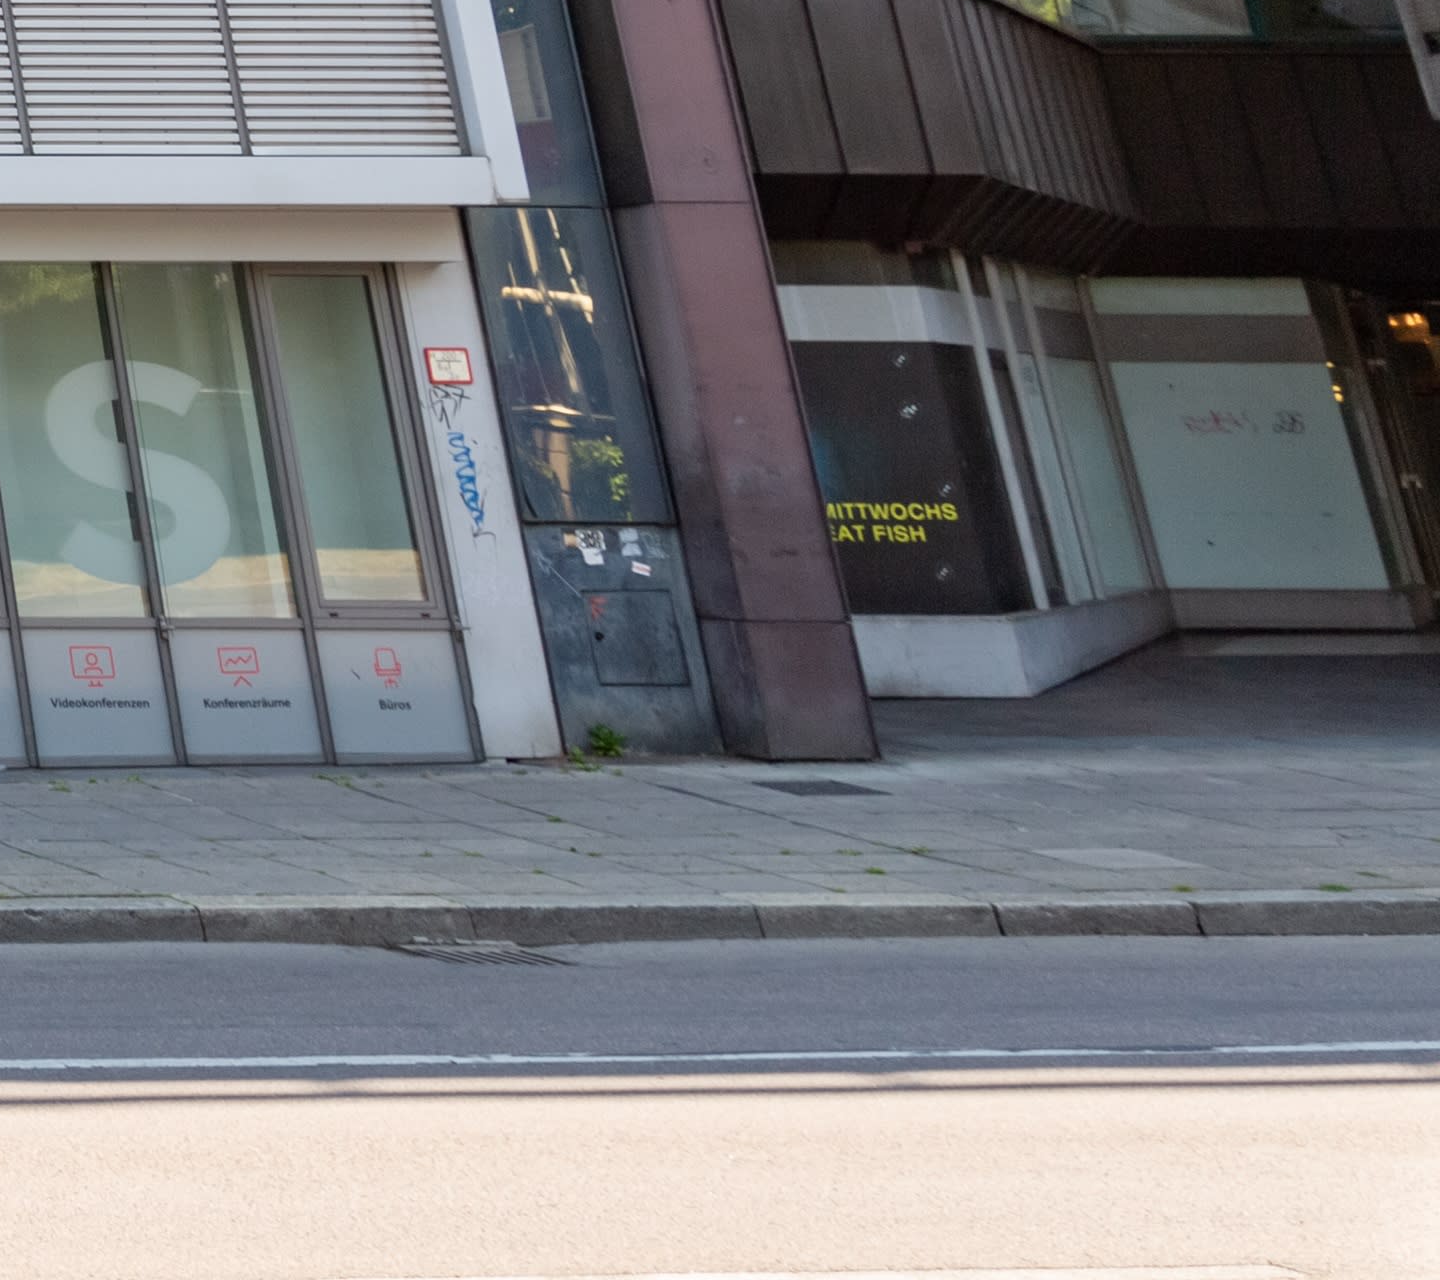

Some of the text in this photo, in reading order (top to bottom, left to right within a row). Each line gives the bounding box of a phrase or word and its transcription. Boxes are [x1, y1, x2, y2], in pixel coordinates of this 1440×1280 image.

[826, 503, 959, 521] MITTWOCHS
[872, 525, 927, 542] FISH
[50, 698, 150, 710] Videokonferenzen
[203, 698, 291, 710] Konferenzräume
[378, 698, 411, 710] Büros
